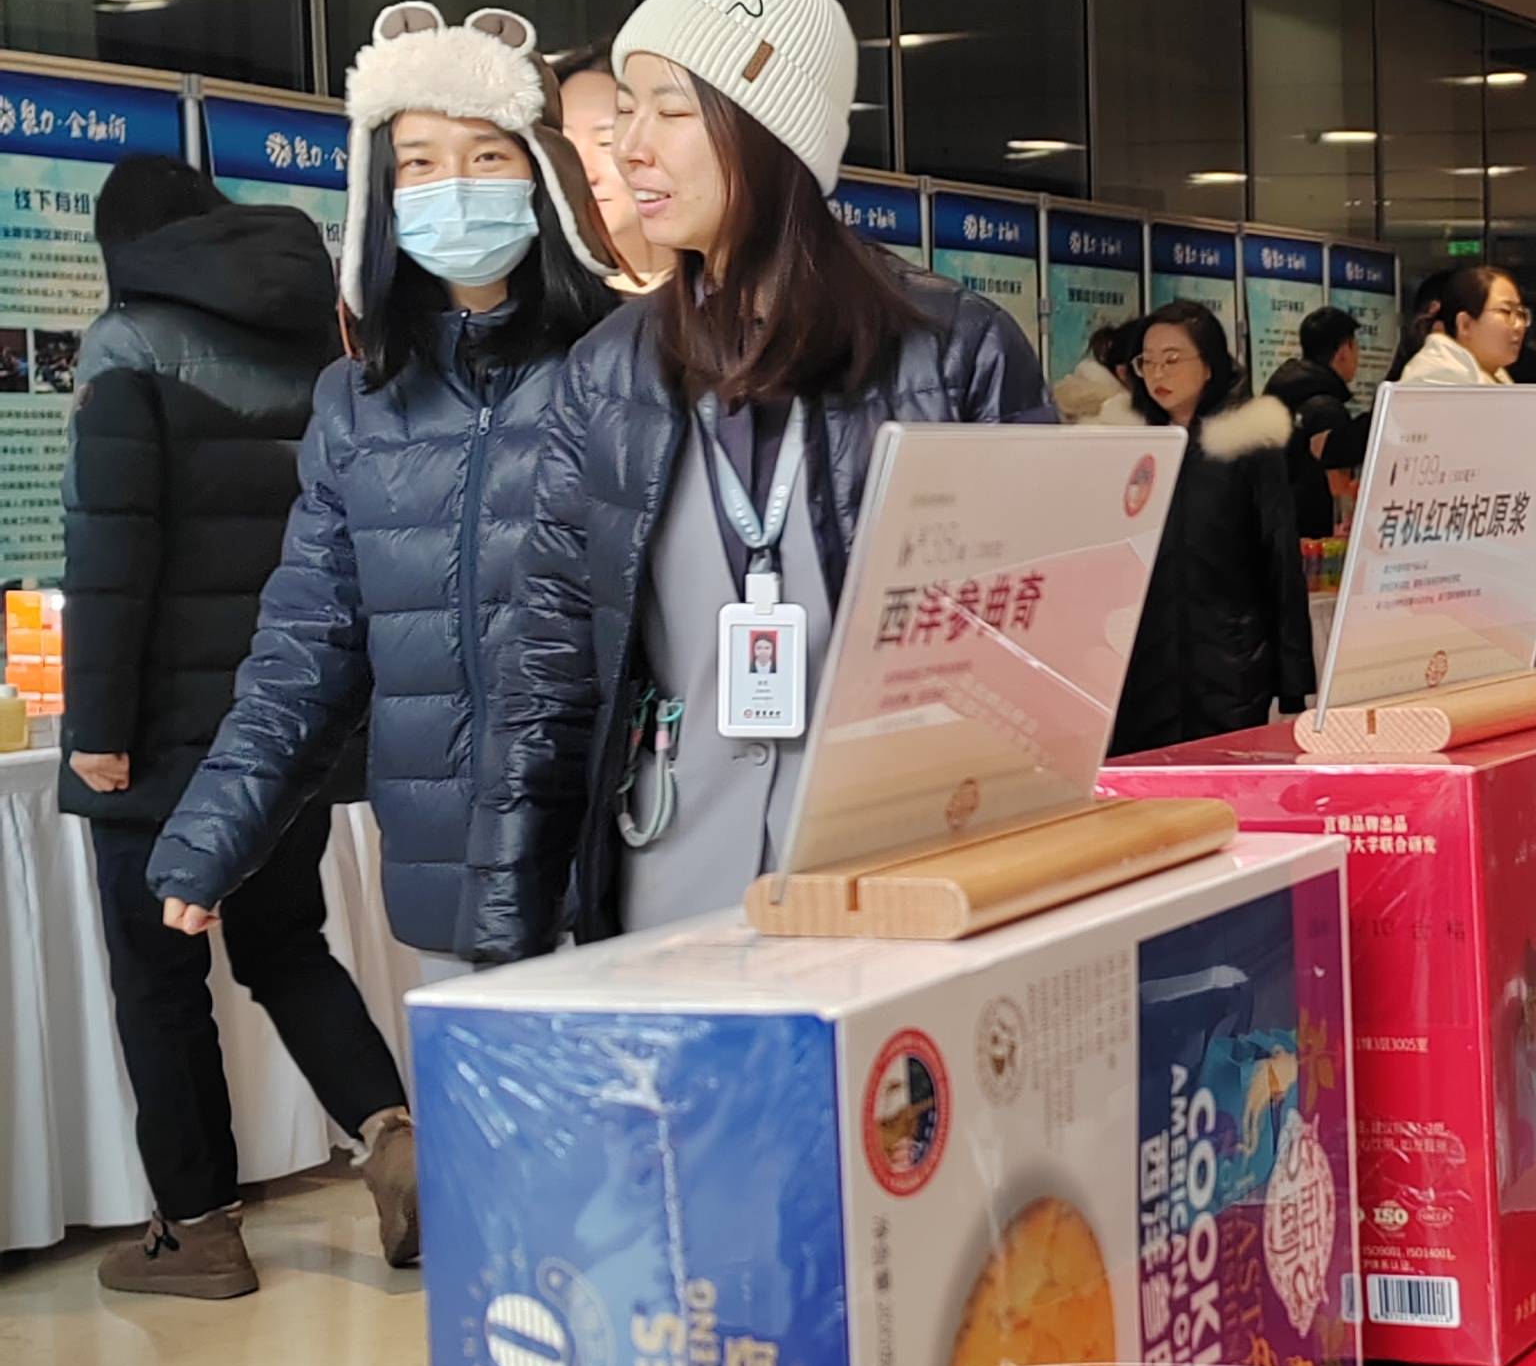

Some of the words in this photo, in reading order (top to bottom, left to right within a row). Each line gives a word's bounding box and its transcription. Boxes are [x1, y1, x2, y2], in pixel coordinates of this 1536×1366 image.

[1378, 491, 1530, 549] 有机红枸杞原浆
[874, 571, 1047, 654] 西洋参曲奇
[1168, 1063, 1190, 1302] AMERICAN
[1373, 1206, 1409, 1226] ISO
